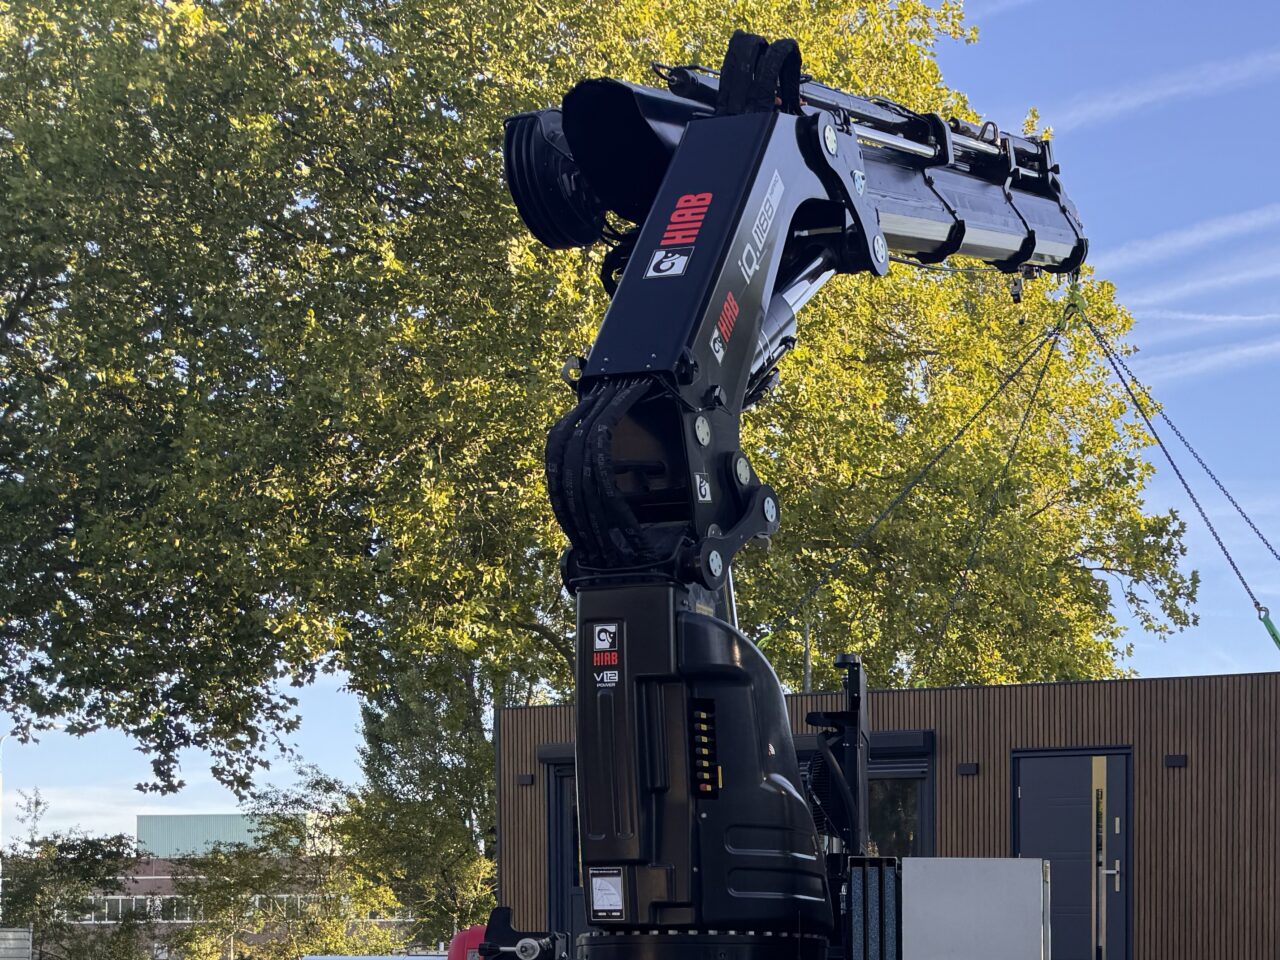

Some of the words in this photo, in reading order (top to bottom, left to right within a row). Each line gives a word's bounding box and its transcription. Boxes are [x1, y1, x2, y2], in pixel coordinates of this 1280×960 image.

[660, 192, 713, 245] HIAB
[717, 291, 740, 343] HIAB
[593, 652, 618, 666] HIAB
